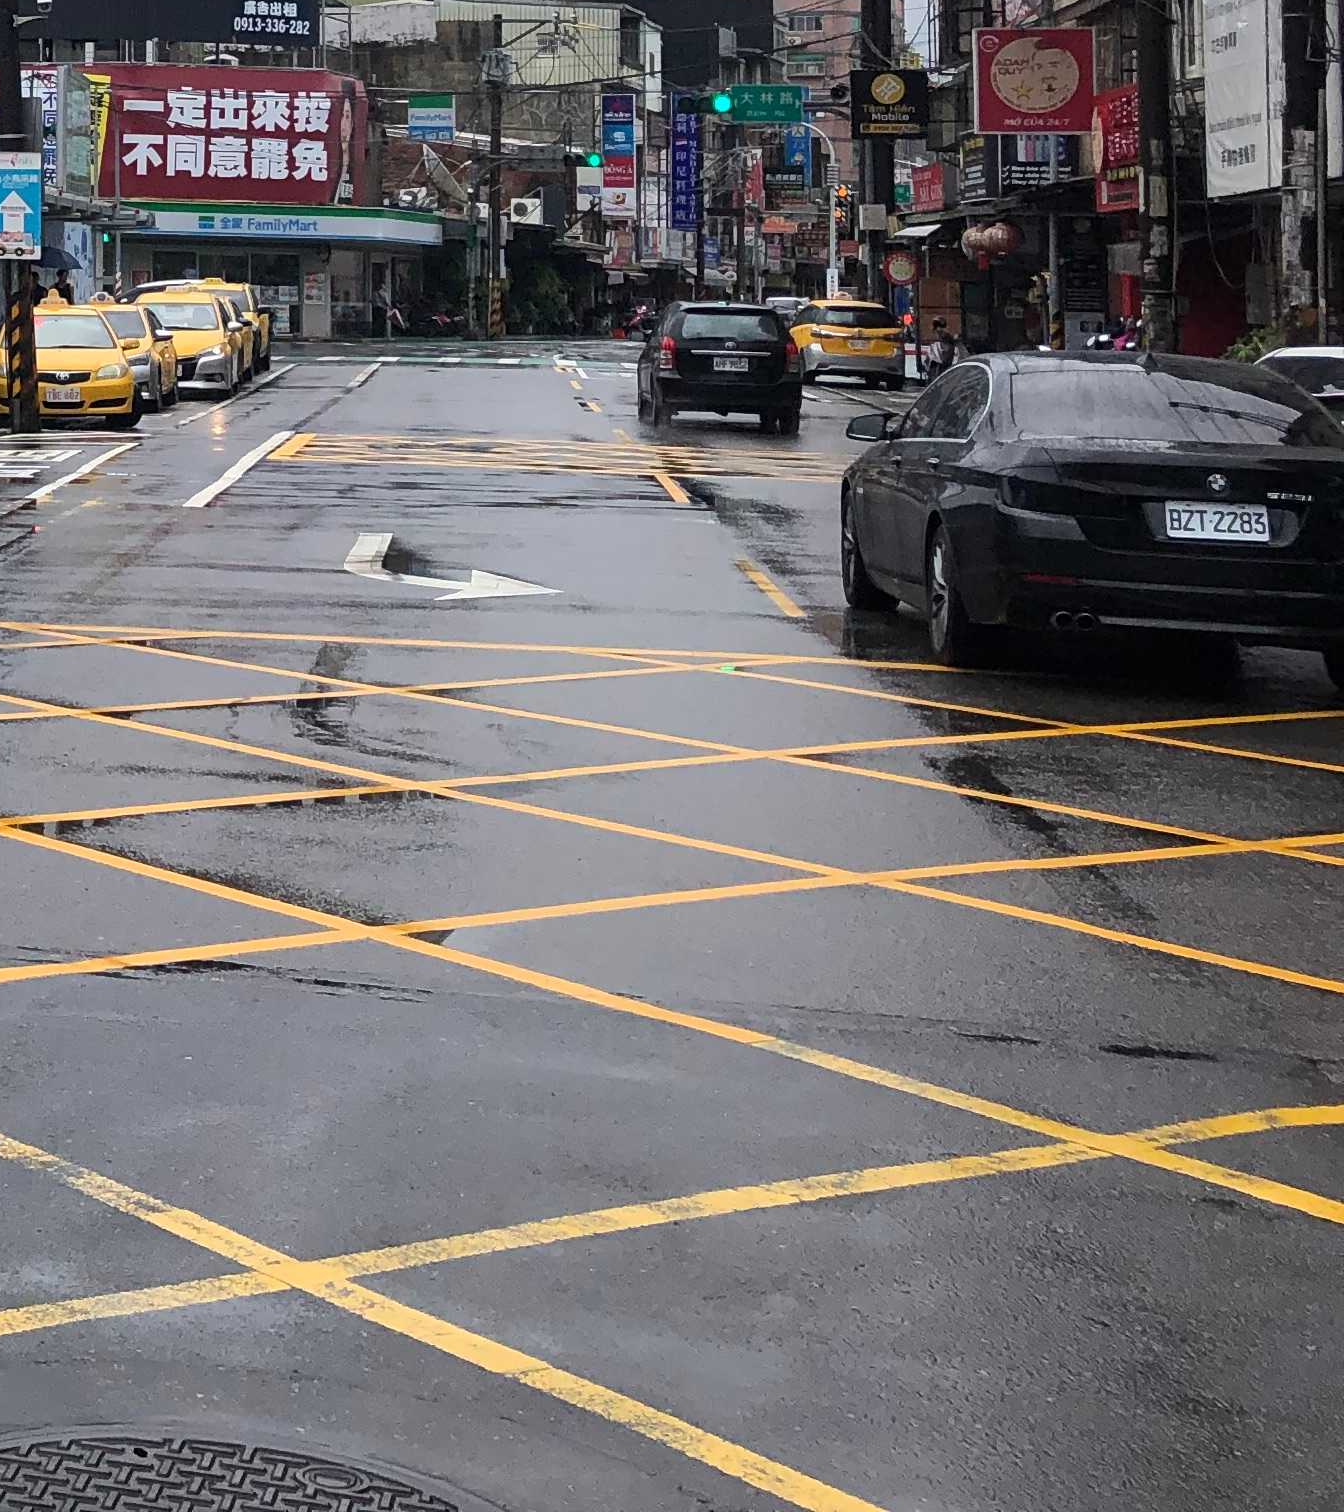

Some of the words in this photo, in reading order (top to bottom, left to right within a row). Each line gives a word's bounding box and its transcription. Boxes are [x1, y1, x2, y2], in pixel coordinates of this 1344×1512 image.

[243, 0, 298, 17] 廣告出租
[233, 16, 310, 35] 0913-336-282
[740, 91, 793, 105] 大林路
[123, 86, 331, 134] 一定出來投
[872, 112, 910, 121] Mobile
[122, 134, 329, 182] 不同意罷免
[219, 216, 243, 230] 全家
[247, 218, 318, 233] FamilyMart
[1168, 507, 1267, 535] BZT-2283
